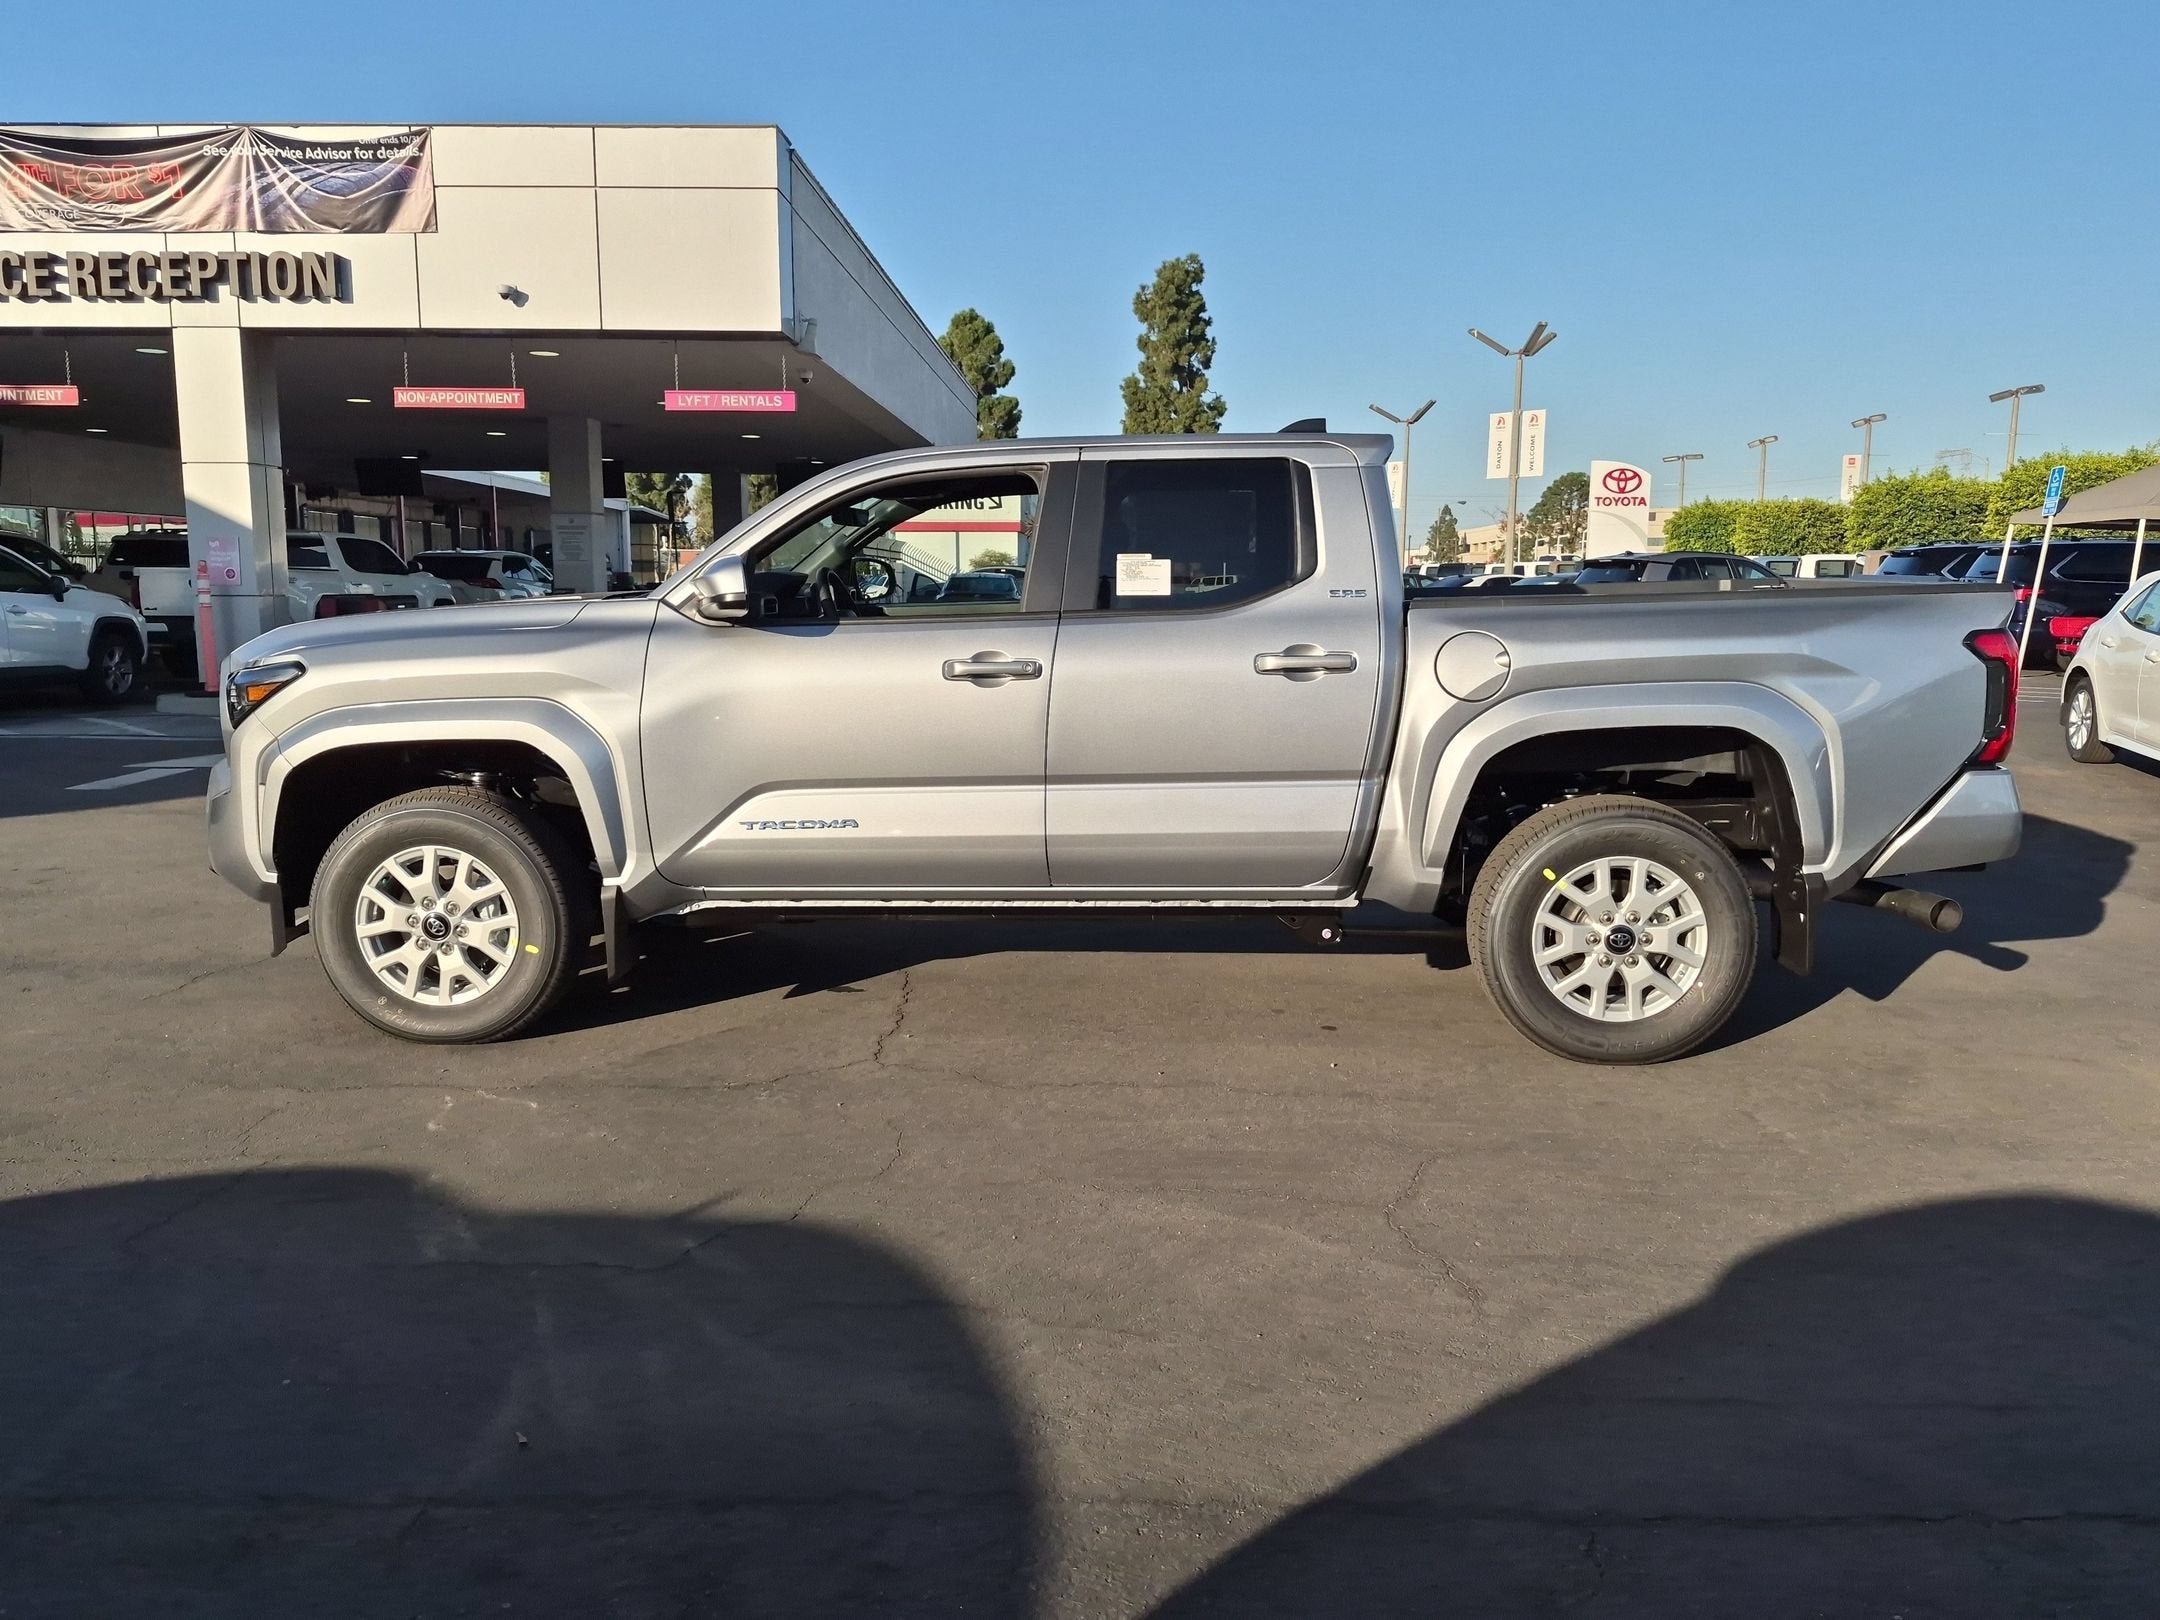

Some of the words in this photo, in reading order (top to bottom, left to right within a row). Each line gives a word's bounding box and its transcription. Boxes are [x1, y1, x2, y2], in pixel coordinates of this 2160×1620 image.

[380, 136, 399, 144] ends
[400, 135, 419, 144] 10/31
[203, 144, 228, 156] See
[260, 144, 303, 159] Service
[305, 146, 350, 160] Advisor
[354, 146, 374, 159] for
[54, 163, 144, 199] FOR
[148, 162, 183, 198] $1
[66, 250, 338, 298] RECEPTION
[0, 389, 63, 401] INTMENT
[397, 391, 521, 404] NON-APPOINTMENT
[678, 395, 711, 407] LYFT
[721, 395, 783, 407] RENTALS
[1594, 496, 1647, 507] TOYOTA
[1329, 589, 1367, 598] SR5
[739, 818, 859, 830] TACOMA
